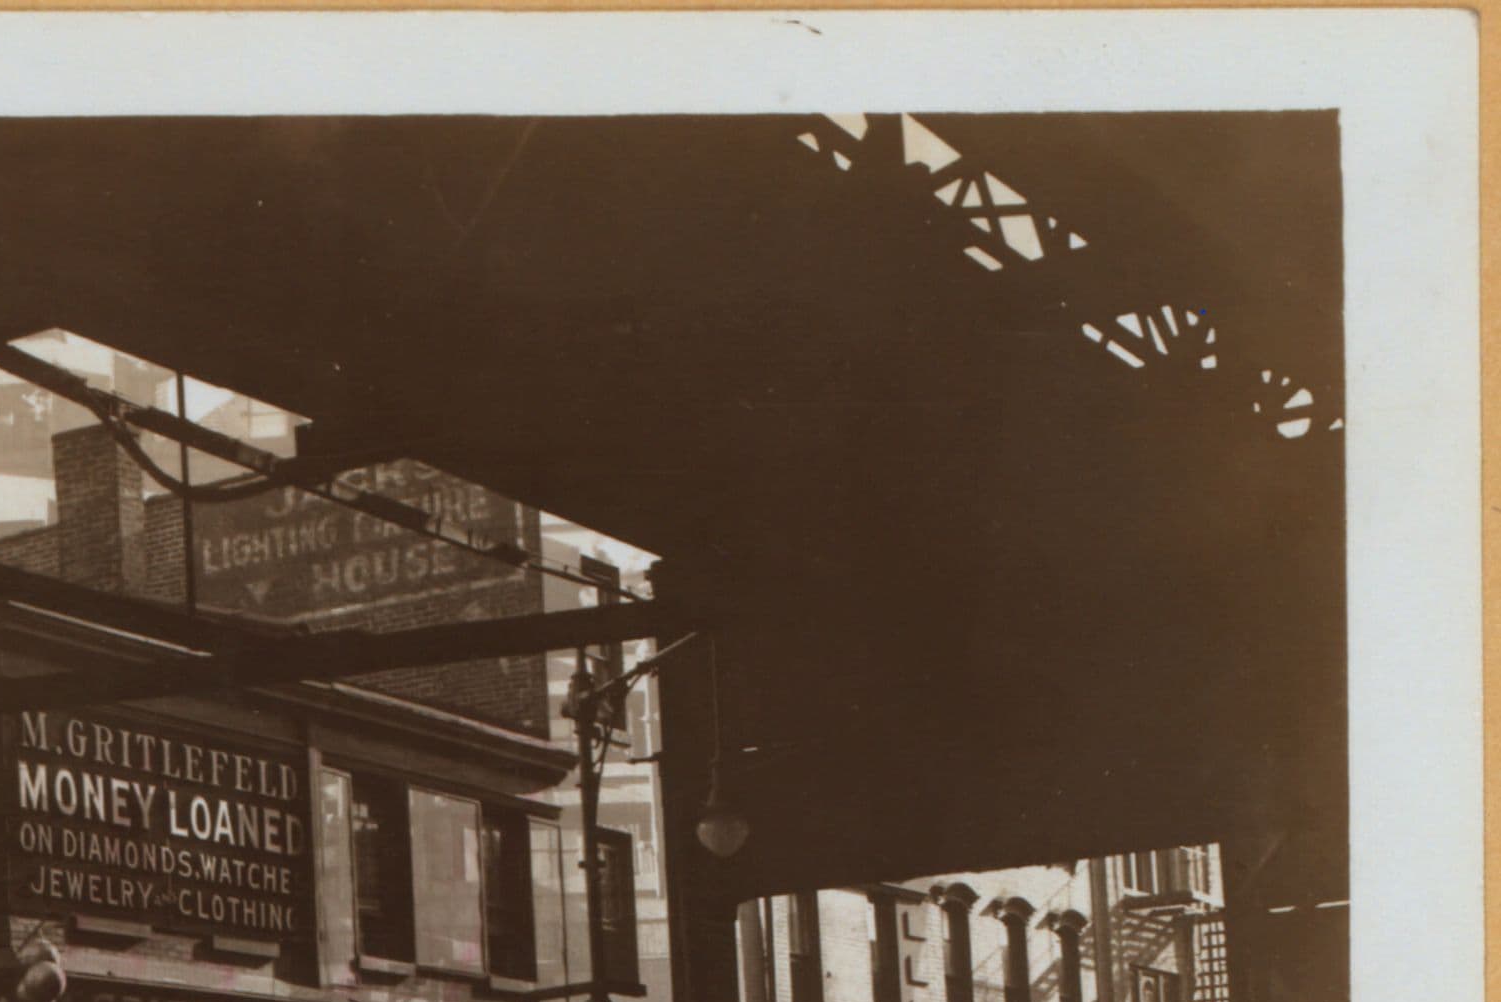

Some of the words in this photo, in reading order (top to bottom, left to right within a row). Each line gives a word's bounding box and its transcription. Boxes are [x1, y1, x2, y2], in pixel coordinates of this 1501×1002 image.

[312, 543, 455, 595] HOUSE
[17, 759, 156, 831] MONEY
[167, 789, 305, 857] LOANED
[19, 821, 54, 854] ON
[30, 865, 154, 910] JEWELRY
